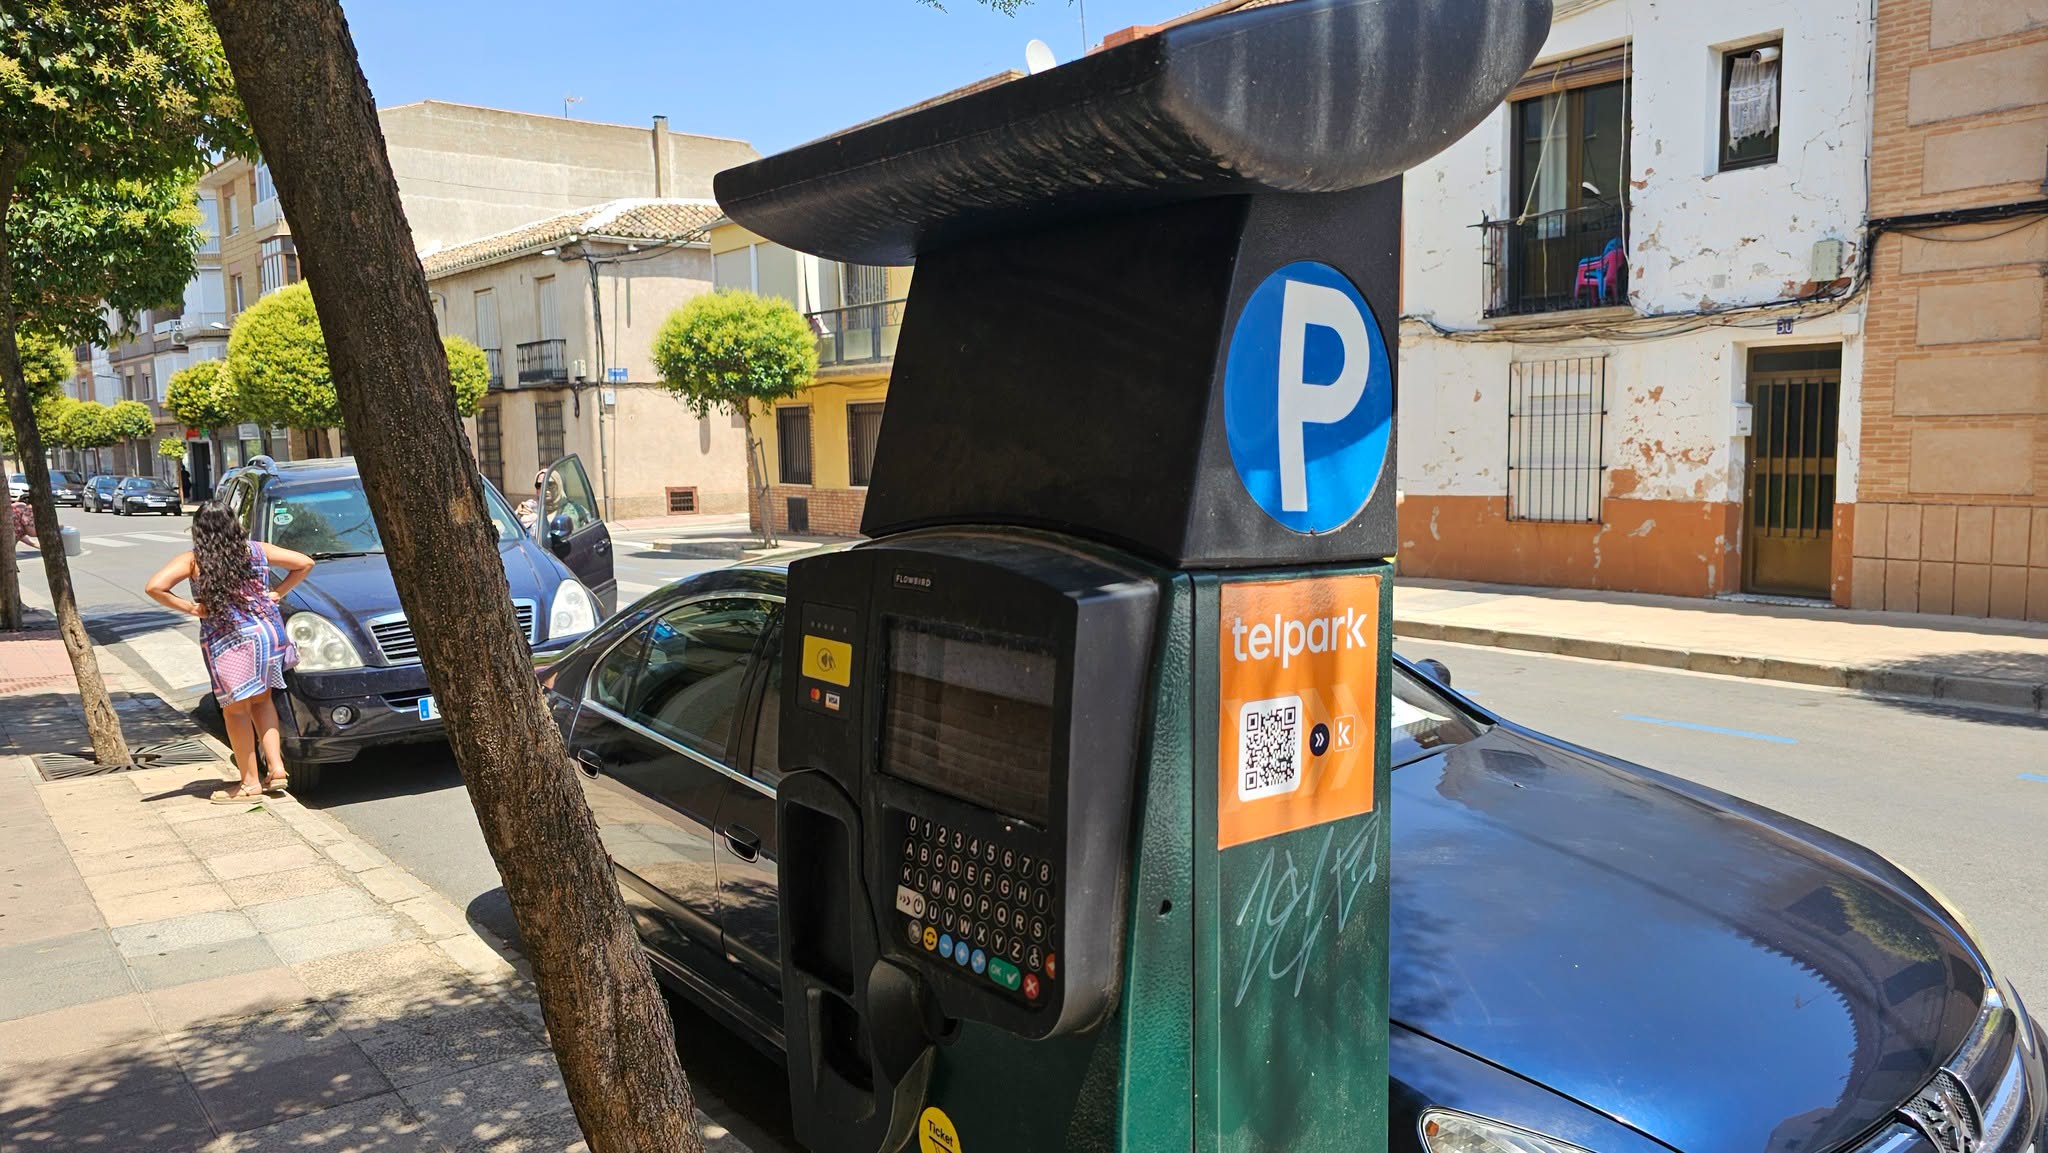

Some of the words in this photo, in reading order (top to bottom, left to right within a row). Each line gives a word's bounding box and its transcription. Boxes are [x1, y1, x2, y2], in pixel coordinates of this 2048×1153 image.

[1278, 280, 1369, 512] P
[1232, 607, 1367, 669] telpark
[906, 843, 914, 853] A
[921, 849, 928, 862] B
[936, 855, 943, 867] C
[951, 860, 959, 874] D
[967, 867, 975, 880] E
[984, 874, 992, 886] F
[1001, 880, 1009, 894] G
[1019, 887, 1027, 901] H
[1039, 894, 1043, 907] I
[910, 816, 916, 831] 0
[925, 822, 931, 837] 1
[939, 827, 946, 843] 2
[955, 833, 962, 849] 3
[970, 839, 978, 855] 4
[987, 845, 995, 861] 5
[1004, 851, 1012, 867] 6
[1023, 858, 1031, 873] 7
[1040, 864, 1049, 881] 8
[903, 867, 910, 880] K
[918, 874, 925, 887] L
[932, 880, 941, 893] M
[948, 887, 956, 900] N
[964, 893, 972, 907] O
[981, 900, 989, 913] P
[997, 907, 1006, 923] Q
[1015, 915, 1024, 928] R
[1034, 922, 1042, 937] S
[930, 906, 937, 919] U
[945, 912, 953, 925] V
[960, 919, 971, 932] W
[977, 927, 986, 941] X
[995, 935, 1003, 949] Y
[1012, 942, 1020, 957] Z
[991, 965, 1001, 976] OK
[928, 1119, 953, 1147] Ticket
